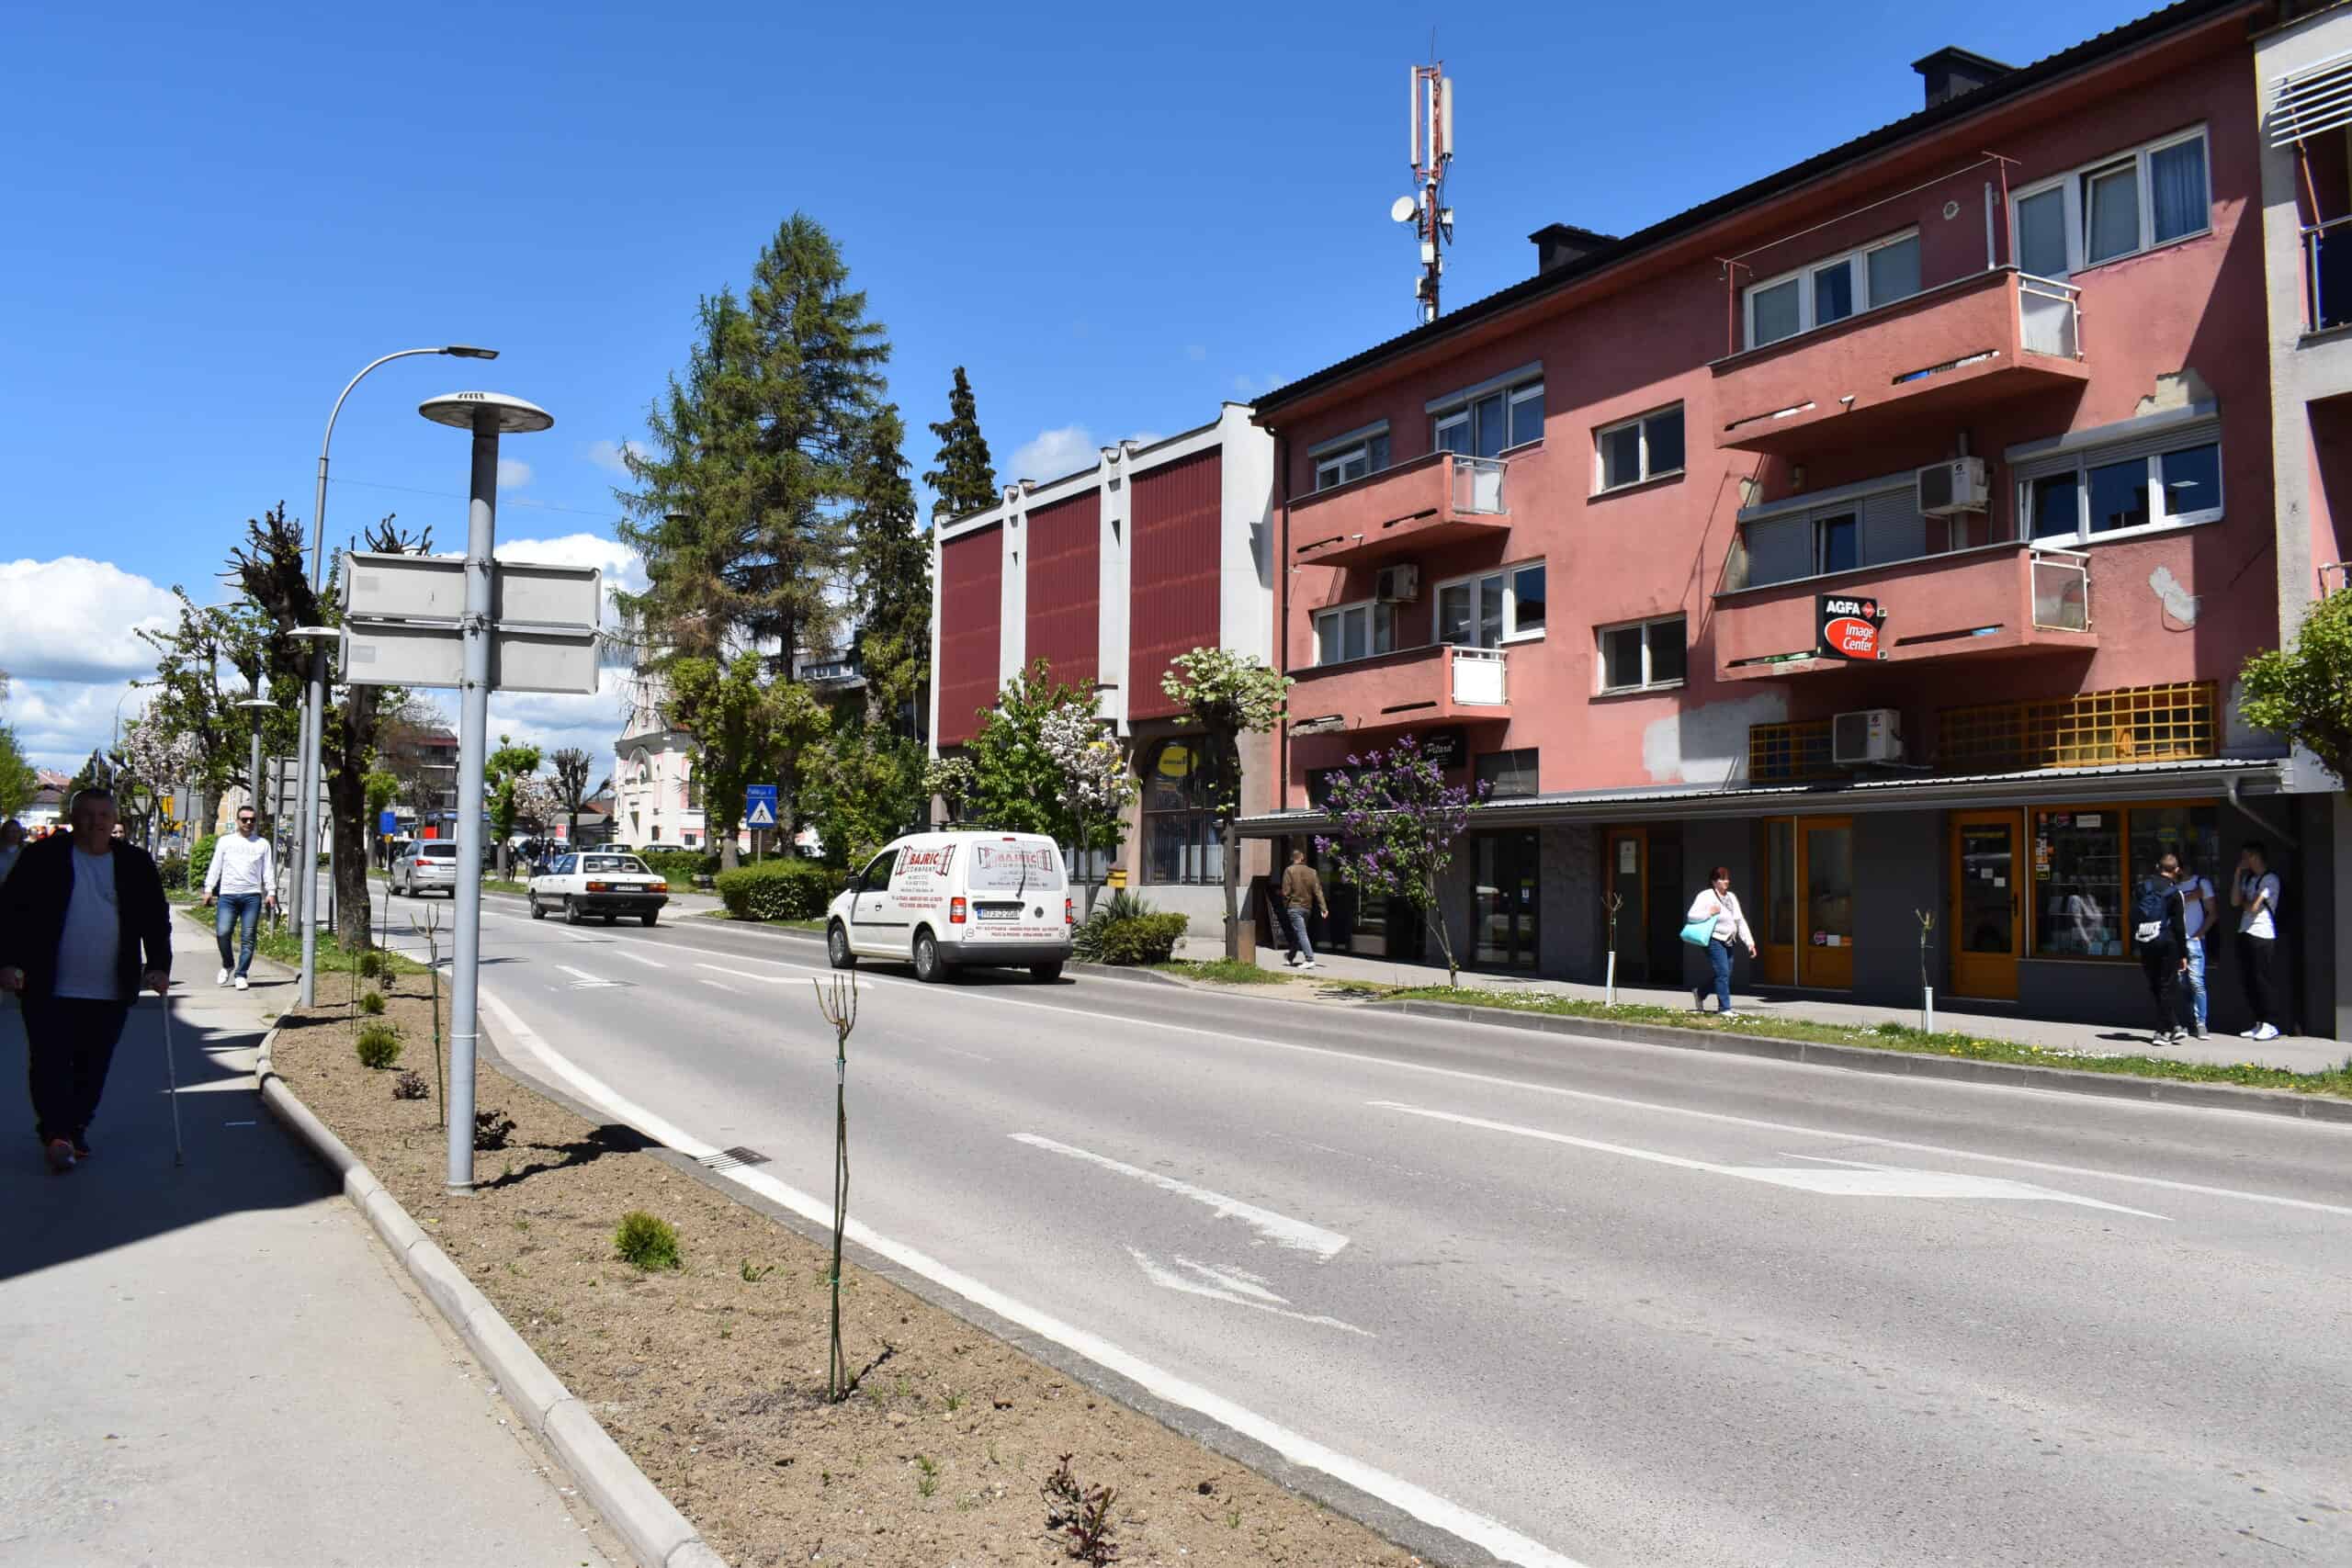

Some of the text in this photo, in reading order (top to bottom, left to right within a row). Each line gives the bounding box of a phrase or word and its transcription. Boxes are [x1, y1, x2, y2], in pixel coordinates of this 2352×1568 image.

[1826, 600, 1860, 615] AGFA
[1846, 623, 1873, 640] Image
[1842, 637, 1873, 651] Center
[2138, 920, 2162, 936] NIKE
